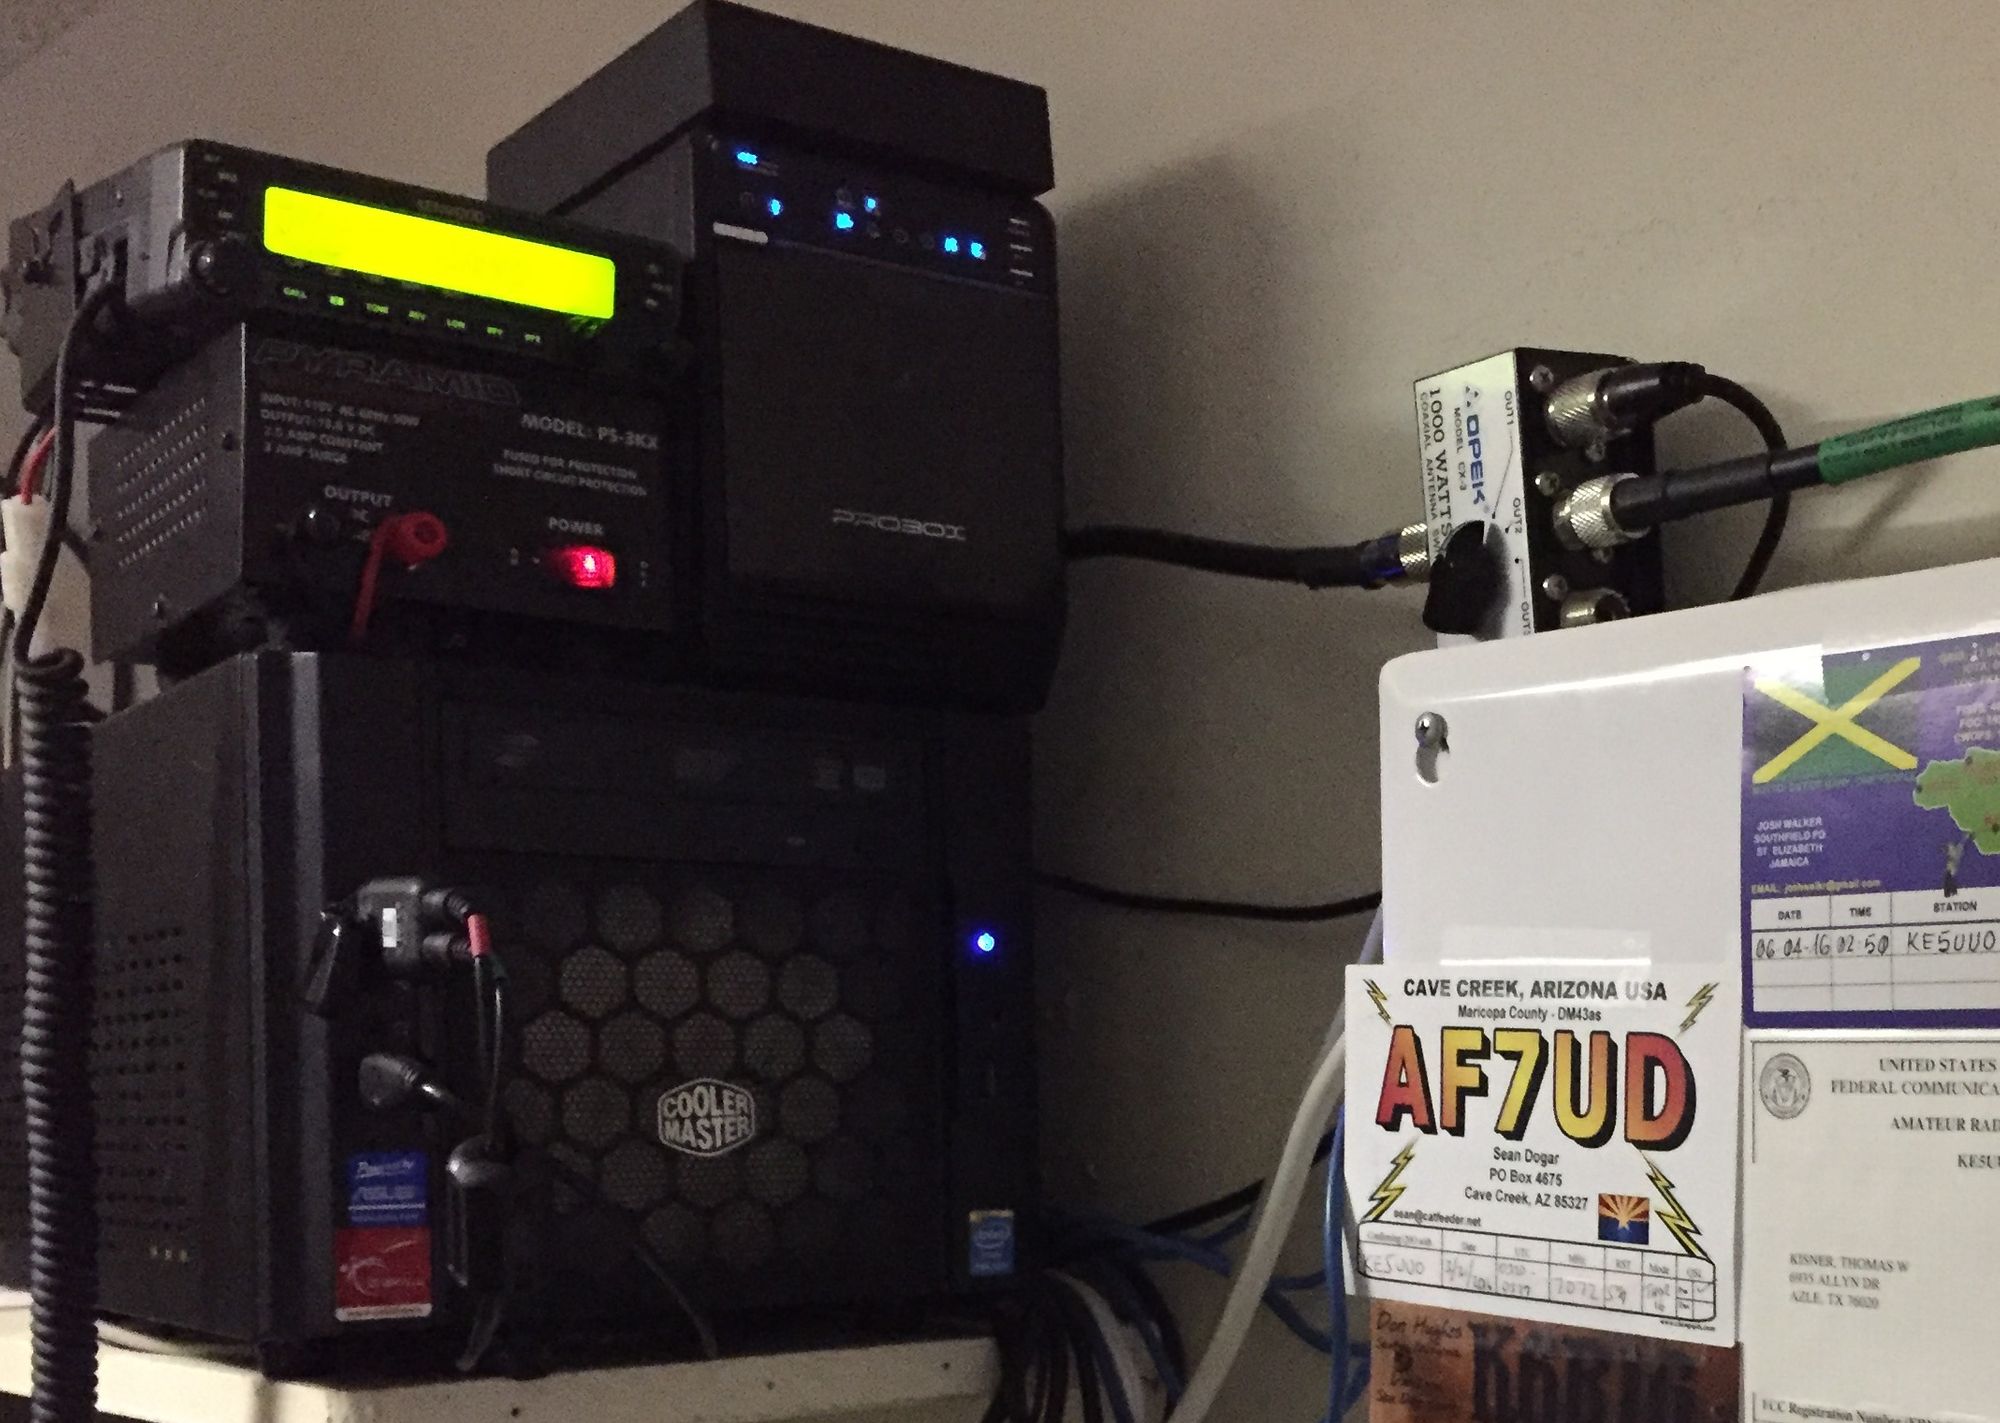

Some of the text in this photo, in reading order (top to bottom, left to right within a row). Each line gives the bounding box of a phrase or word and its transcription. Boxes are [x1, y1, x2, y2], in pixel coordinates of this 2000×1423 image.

[1504, 390, 1514, 426] OUT1
[521, 413, 585, 438] MODEL
[1454, 407, 1464, 454] MODEL
[1420, 392, 1432, 451] COAXIAL
[1426, 458, 1438, 521] ANTENNA
[1429, 387, 1453, 537] 1000 WATTS
[1466, 414, 1486, 505] OPEK
[324, 484, 393, 508] OUTPUT
[548, 516, 605, 536] POWER
[832, 508, 966, 542] PROBOX
[1512, 496, 1523, 536] OUT2
[1757, 816, 1824, 832] JOSH WALKER
[1772, 843, 1824, 855] ELIZABETH
[1769, 856, 1810, 869] JAMAICA
[1778, 900, 1978, 921] DATE TIME STATION
[1403, 978, 1668, 1002] CAVE CREEK, ARIZONA USA
[1458, 1004, 1506, 1021] Maricopa
[1509, 1006, 1548, 1022] County
[1558, 1006, 1602, 1021] DM43as
[1880, 1058, 1998, 1072] UNITED STATES
[1376, 1025, 1697, 1152] AF7UD
[1831, 1080, 1897, 1094] FEDERAL
[663, 1085, 750, 1118] COOLER
[664, 1116, 751, 1150] MASTER
[1891, 1116, 1967, 1132] AMATEUR
[1493, 1146, 1560, 1168] Sean Dogar
[1489, 1168, 1563, 1187] PO Box 4675
[1464, 1186, 1588, 1211] Cave Creek, AZ 85327
[1841, 1256, 1894, 1272] THOMAS
[1862, 1277, 1880, 1290] DR
[1828, 1292, 1844, 1306] TX
